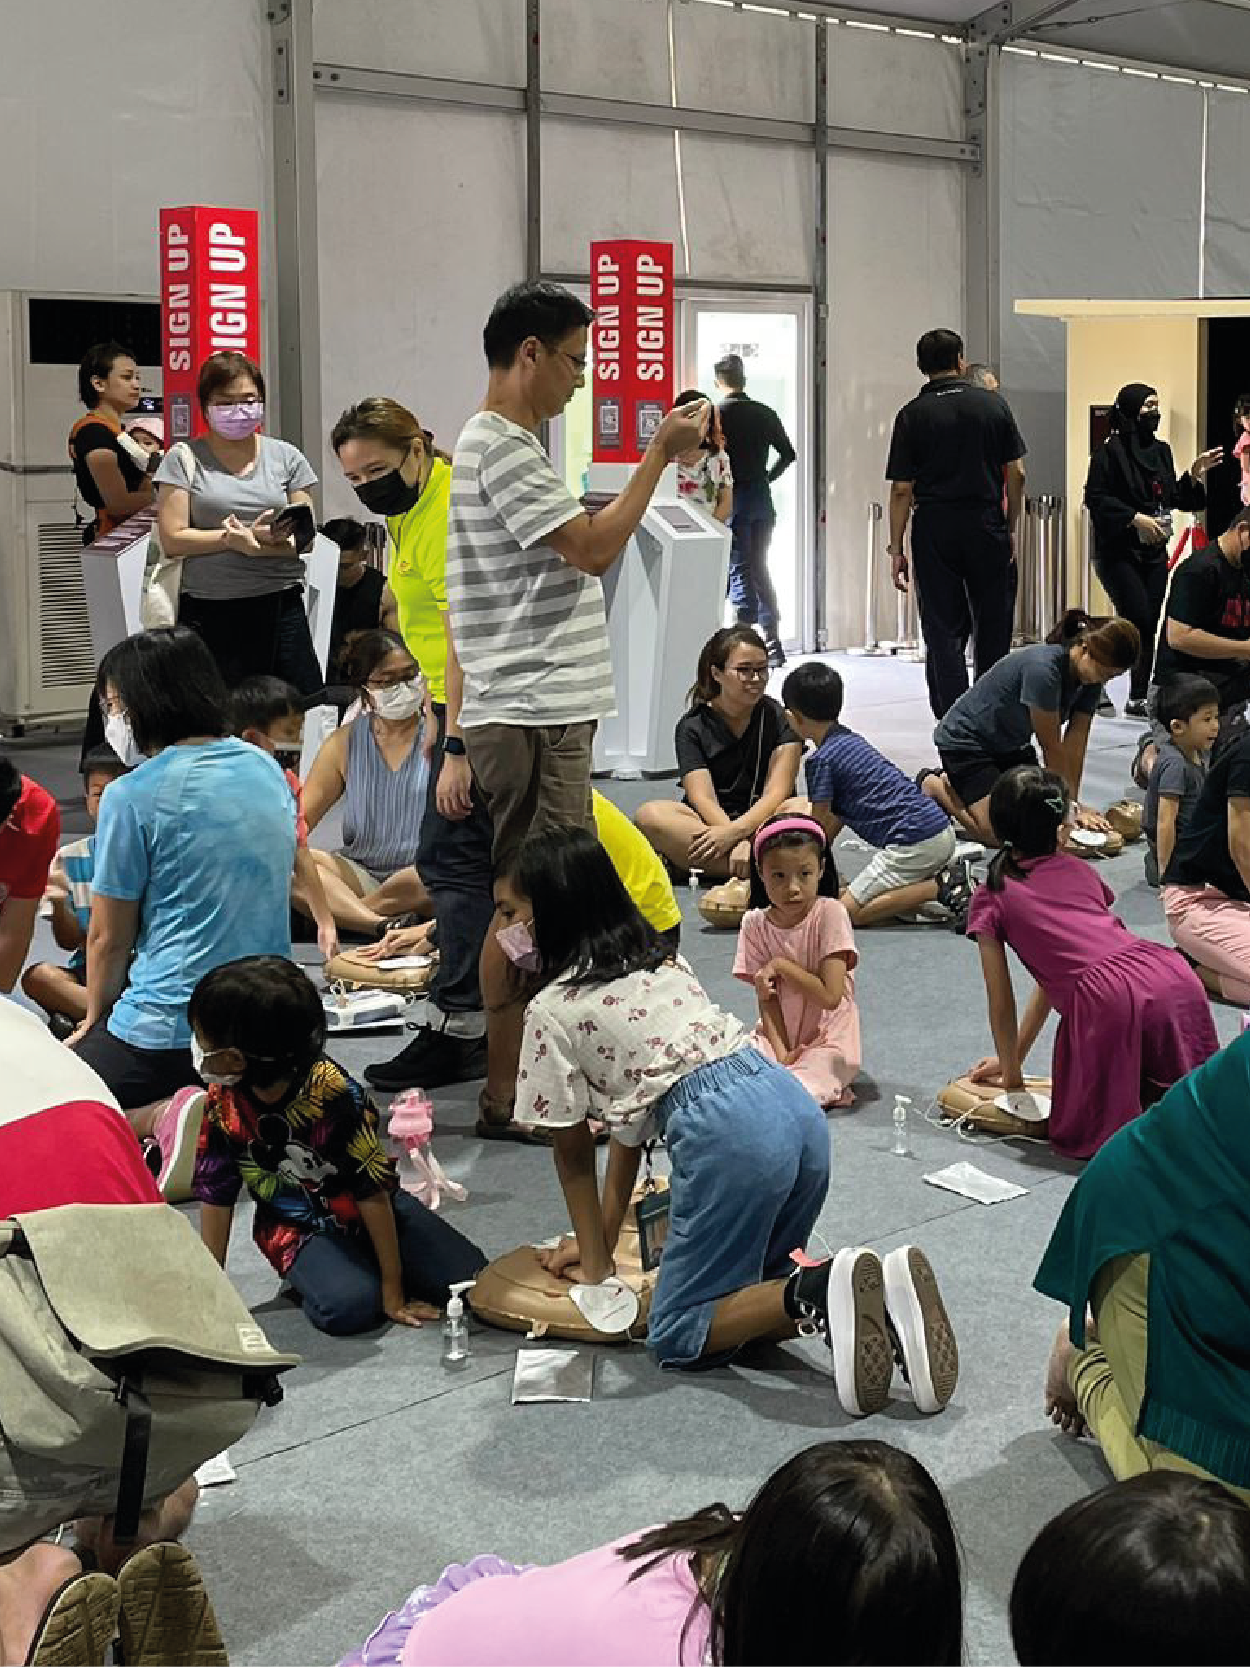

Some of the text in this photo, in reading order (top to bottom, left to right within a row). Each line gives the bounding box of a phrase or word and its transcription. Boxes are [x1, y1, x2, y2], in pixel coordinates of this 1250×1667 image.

[168, 223, 191, 371] SIGN UP
[209, 223, 248, 354] IGN UP
[598, 254, 620, 381] SIGN UP
[637, 254, 664, 381] SIGN UP
